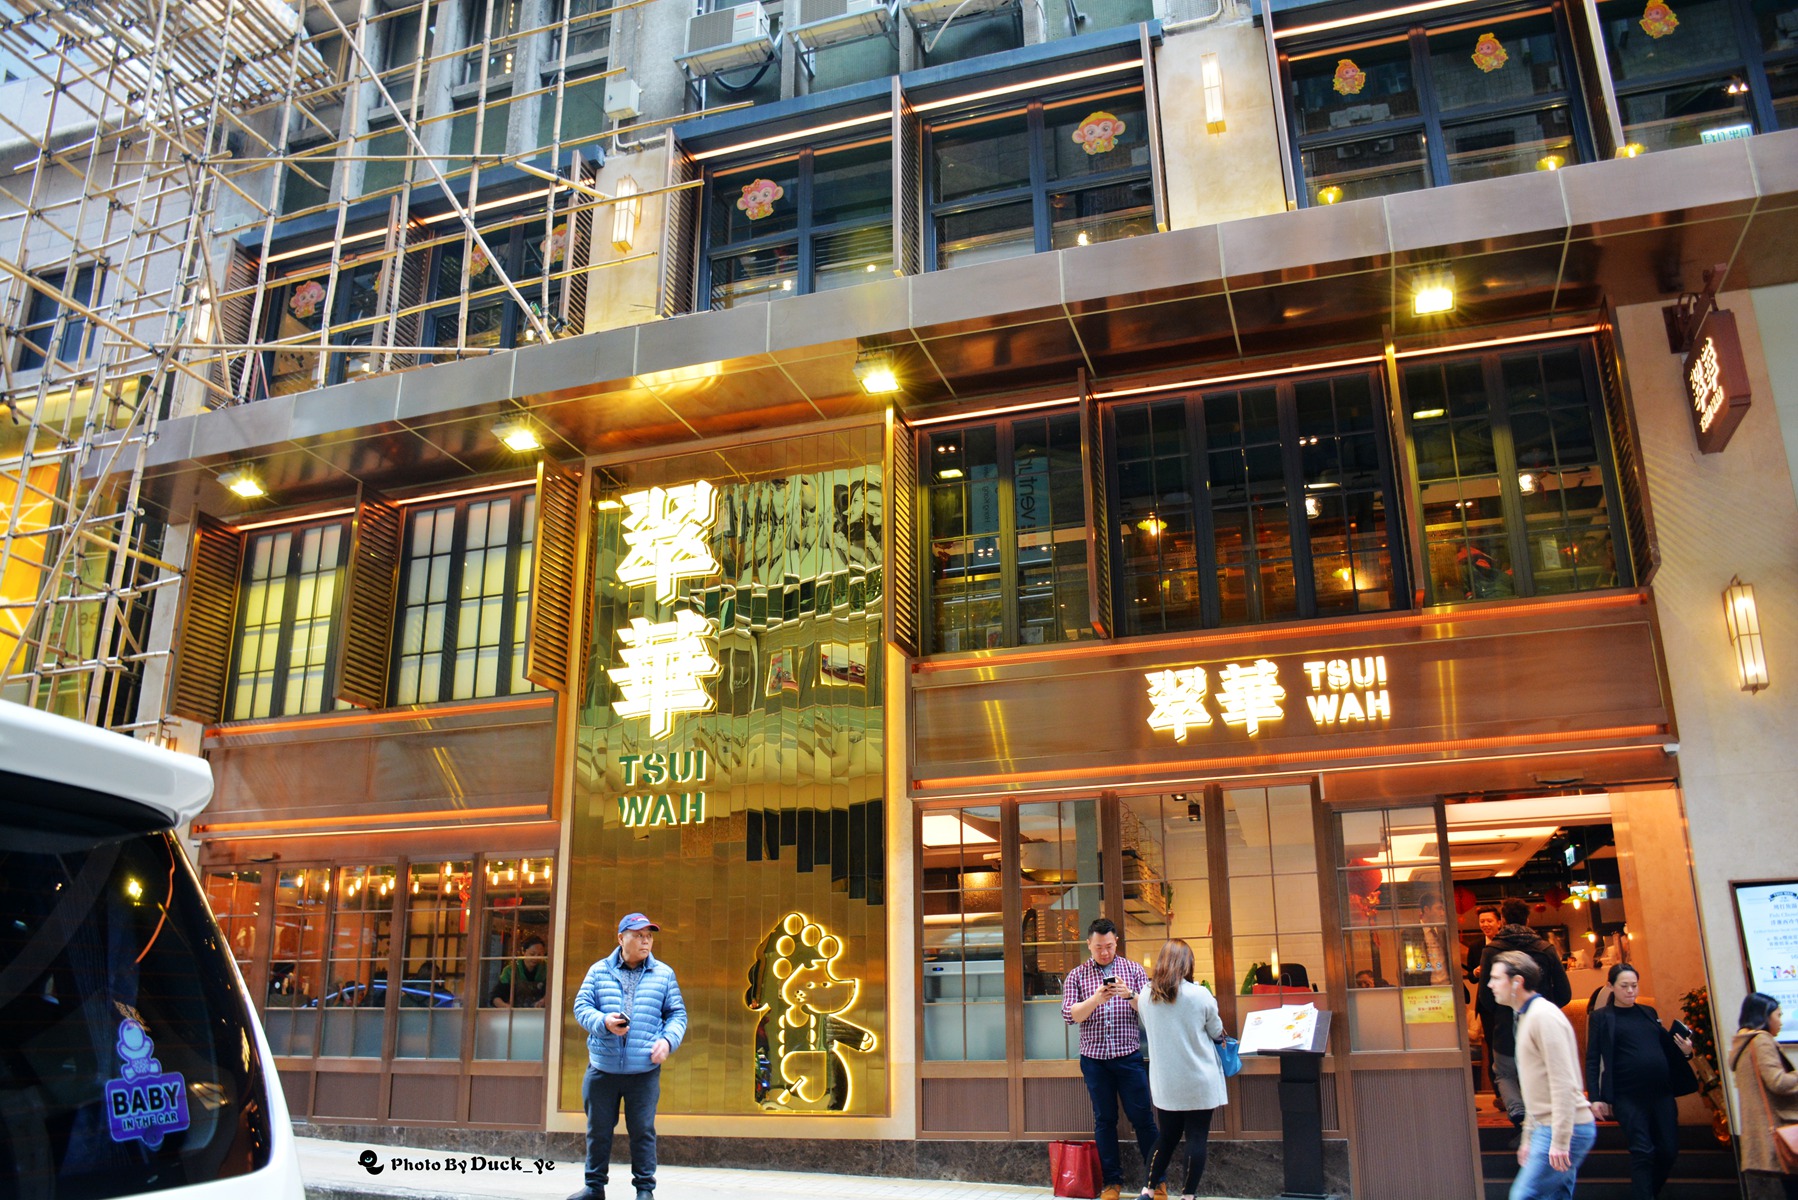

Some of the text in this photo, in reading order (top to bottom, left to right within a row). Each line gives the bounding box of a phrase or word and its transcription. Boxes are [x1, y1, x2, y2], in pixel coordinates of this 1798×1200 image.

[607, 479, 724, 741] 翠華
[1303, 656, 1387, 690] TSUI
[1144, 659, 1286, 742] 翠華
[1306, 690, 1390, 724] WAH
[619, 750, 706, 786] TSUI
[617, 792, 706, 828] WAH
[112, 1082, 180, 1117] BABY
[122, 1111, 178, 1131] IN THE CAR
